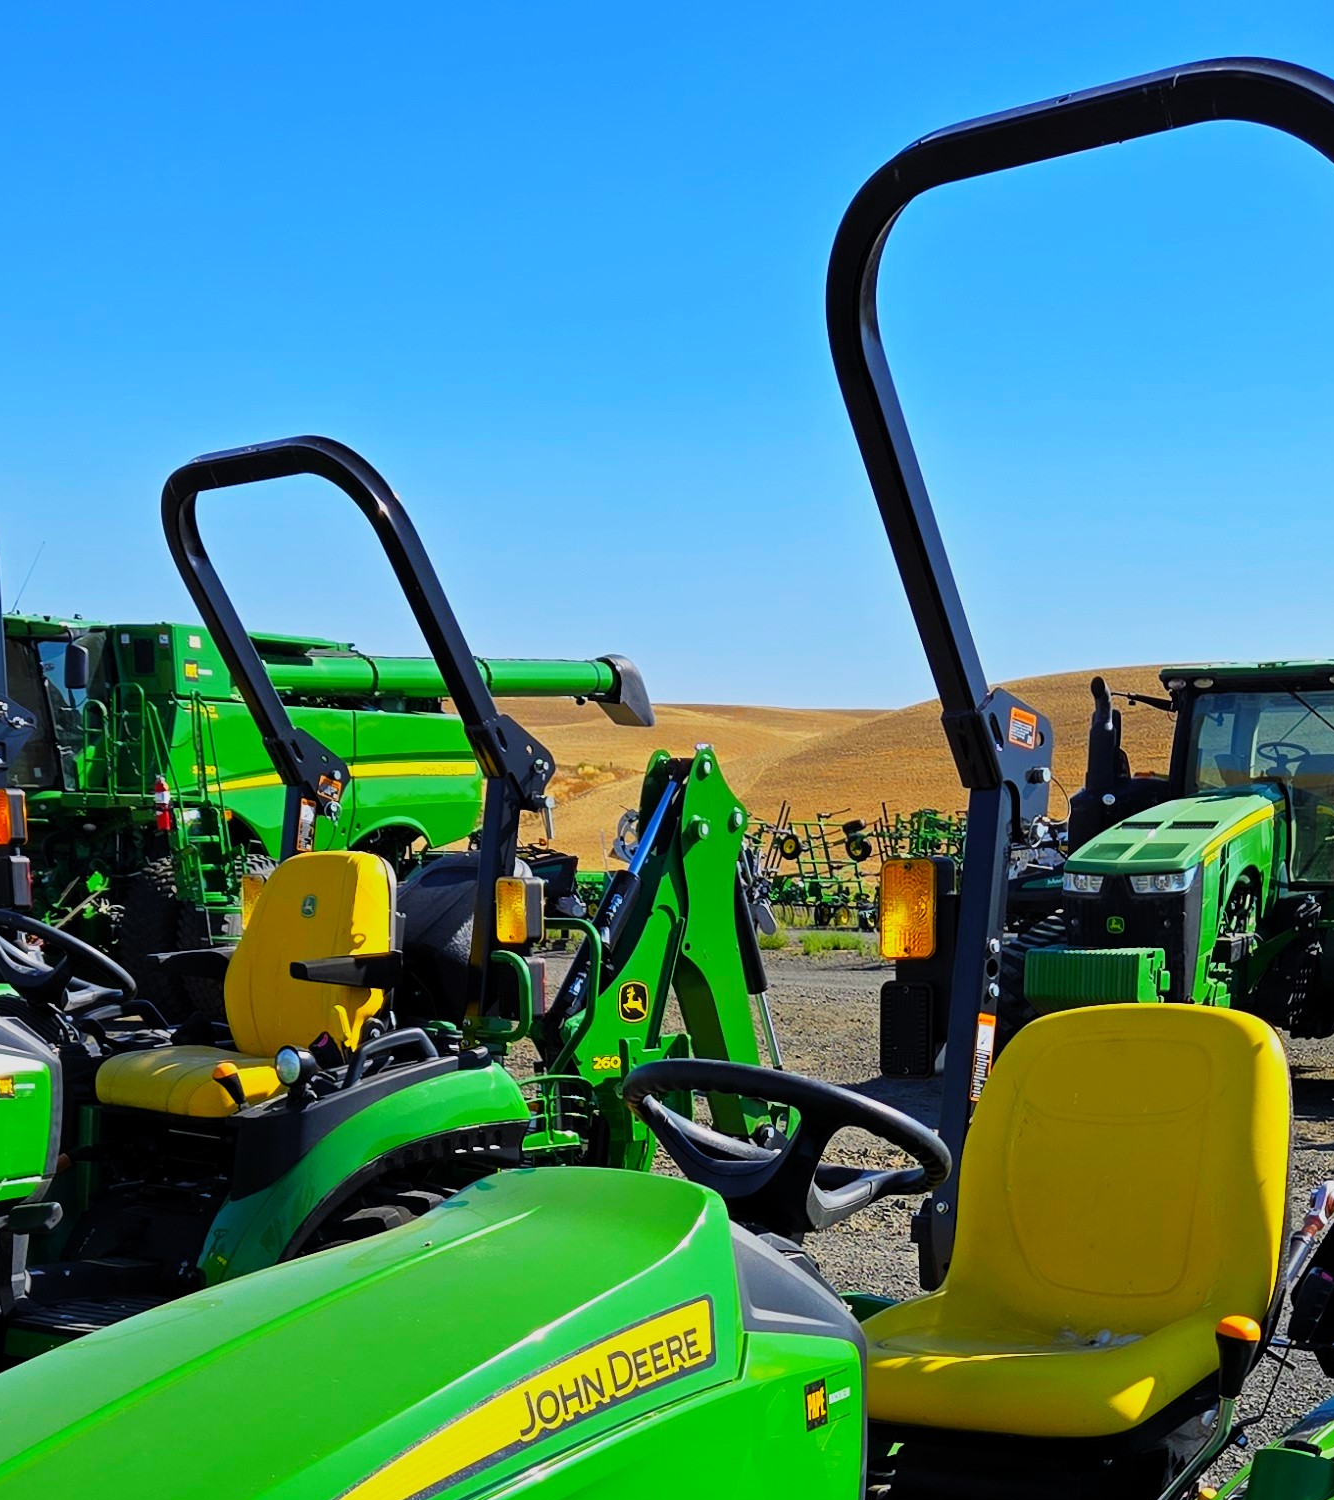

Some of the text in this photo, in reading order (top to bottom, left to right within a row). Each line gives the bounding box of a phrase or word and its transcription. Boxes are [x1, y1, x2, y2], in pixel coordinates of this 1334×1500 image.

[592, 1055, 622, 1071] 260
[519, 1326, 703, 1428] JOHN DEERE
